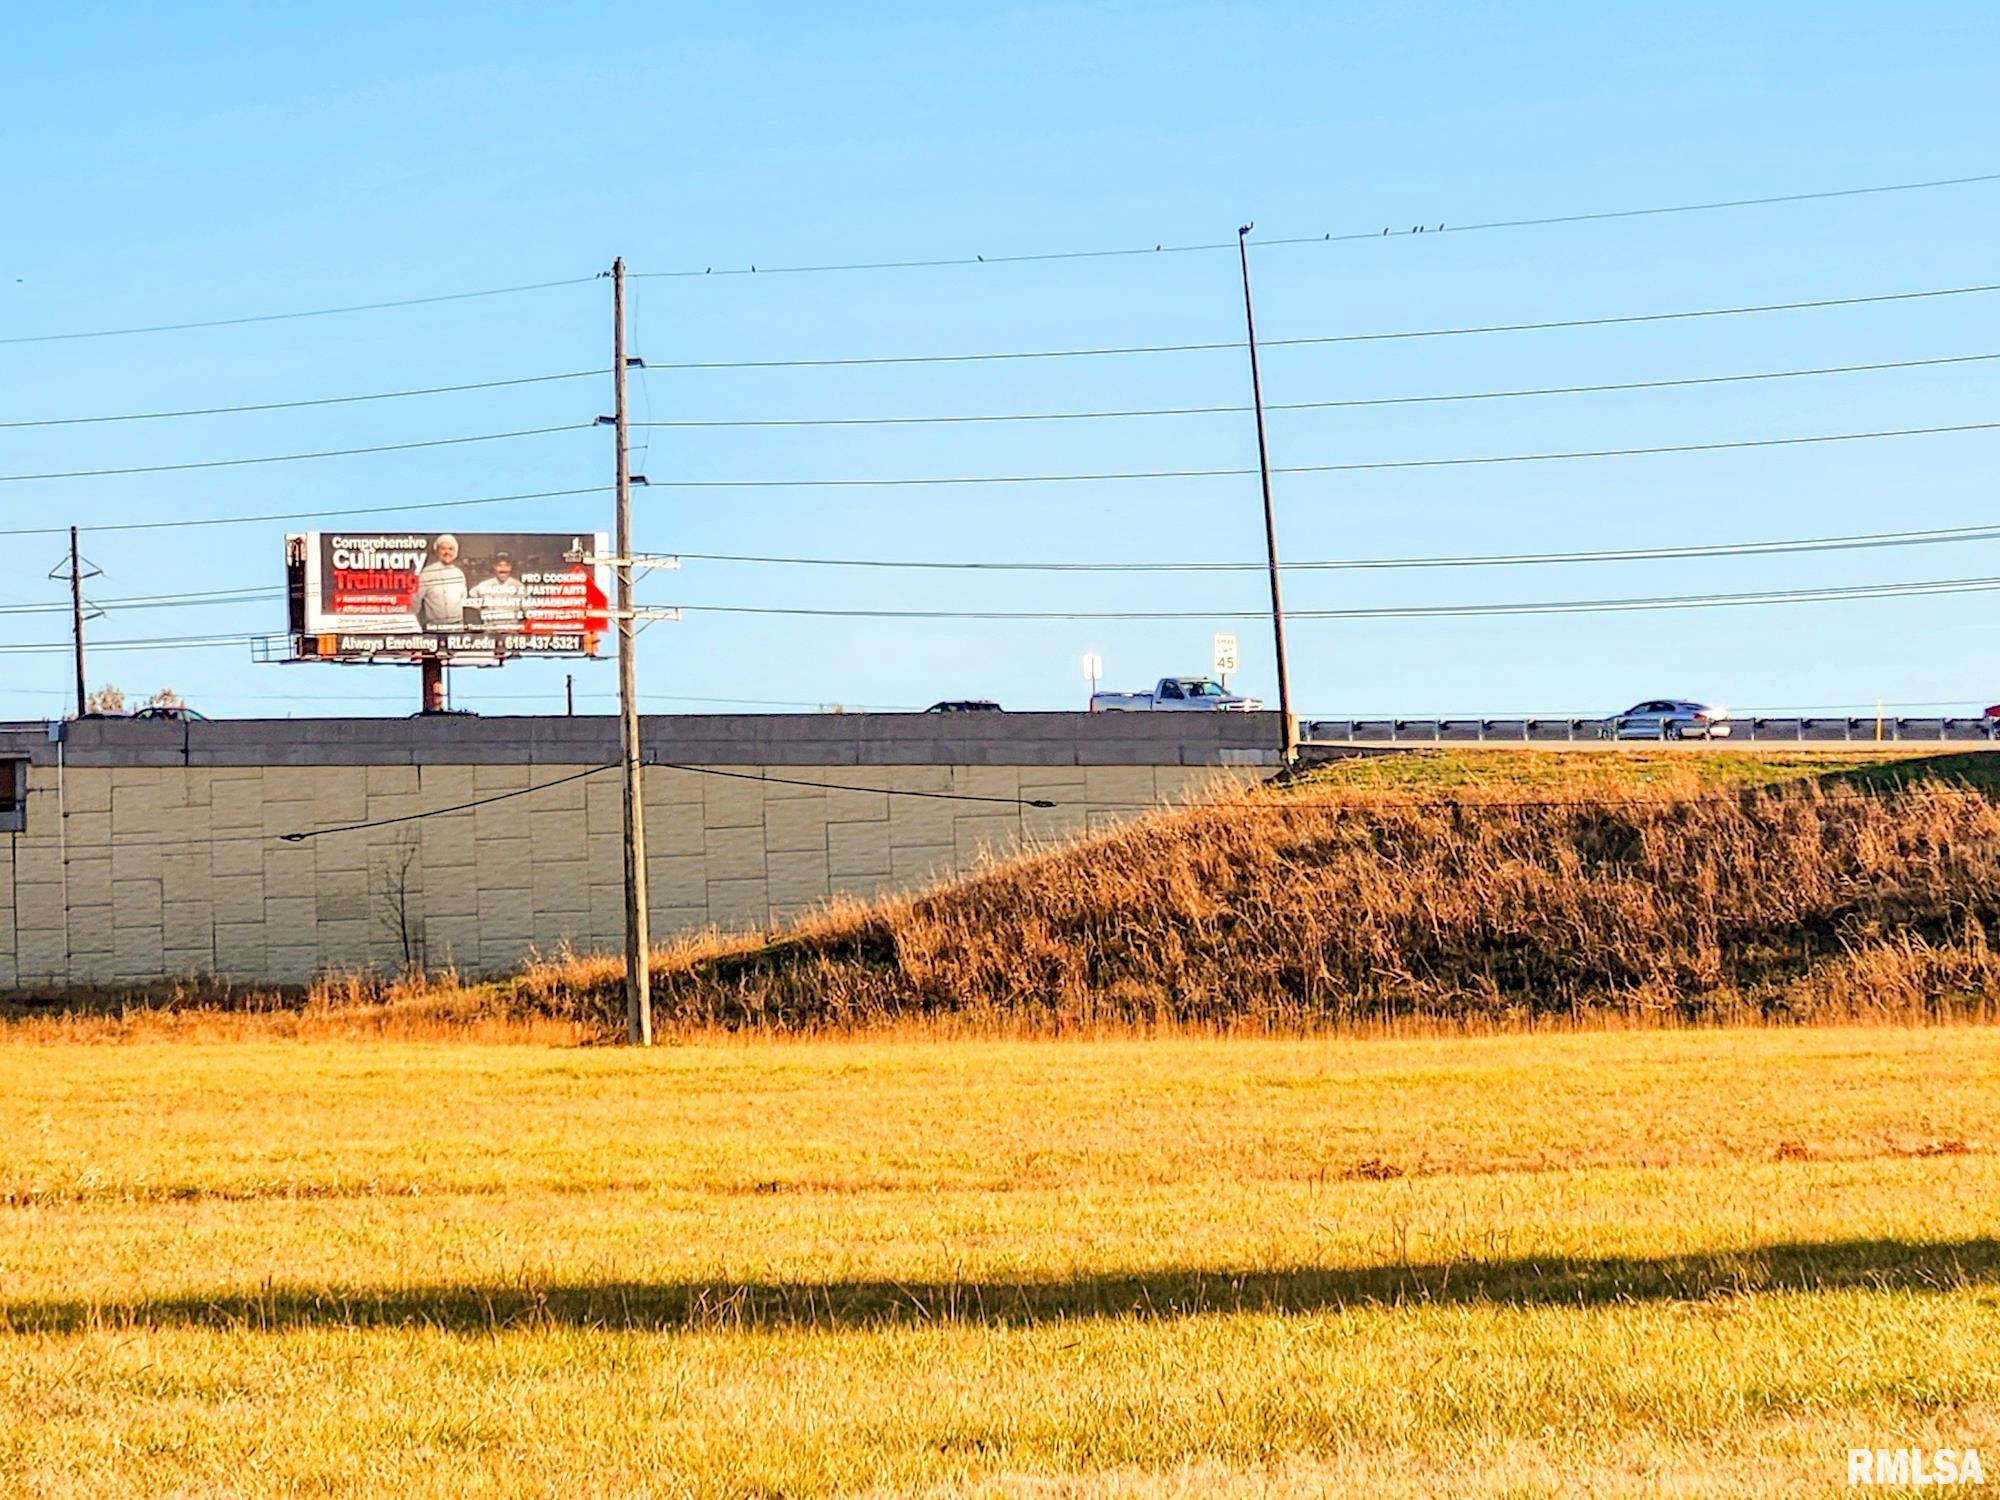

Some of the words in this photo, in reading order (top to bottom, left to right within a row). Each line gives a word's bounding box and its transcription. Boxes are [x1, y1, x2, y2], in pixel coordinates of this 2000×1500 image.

[332, 535, 427, 553] Comprehensive
[333, 549, 428, 575] Culinary
[334, 570, 419, 593] Training
[521, 573, 541, 583] PRO
[543, 573, 587, 583] COOKING
[481, 585, 517, 596] AKING
[527, 585, 562, 595] PASTRY
[563, 585, 587, 595] ARTS
[461, 597, 521, 608] ESTAURANT
[522, 597, 587, 608] MANAGEMENT
[341, 637, 384, 652] Always
[386, 635, 438, 651] Enrolling
[448, 636, 495, 650] RLC.edu
[504, 636, 580, 650] 618-437-5321
[1217, 656, 1234, 669] 45
